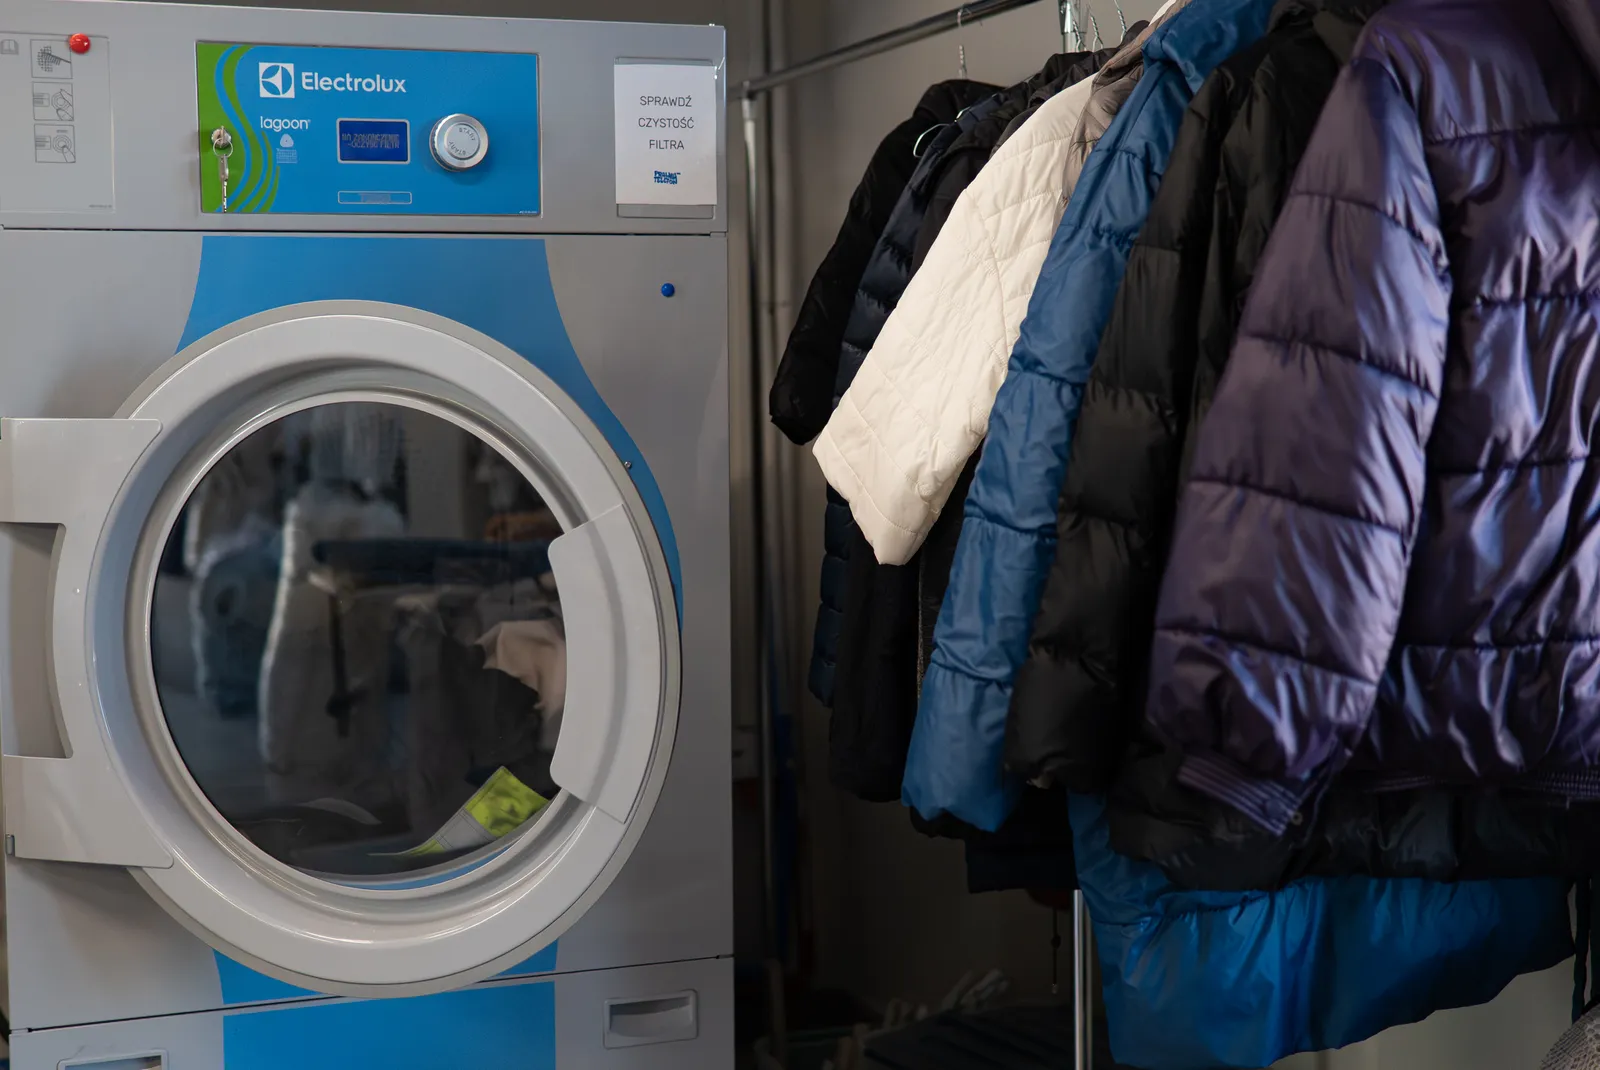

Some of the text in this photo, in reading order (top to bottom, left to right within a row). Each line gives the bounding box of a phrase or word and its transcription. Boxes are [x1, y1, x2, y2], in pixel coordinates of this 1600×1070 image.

[301, 71, 407, 93] Electrolux
[640, 95, 692, 107] SPRAWDŹ
[638, 116, 694, 129] CZYSTOŚĆ
[649, 139, 685, 150] FILTRA
